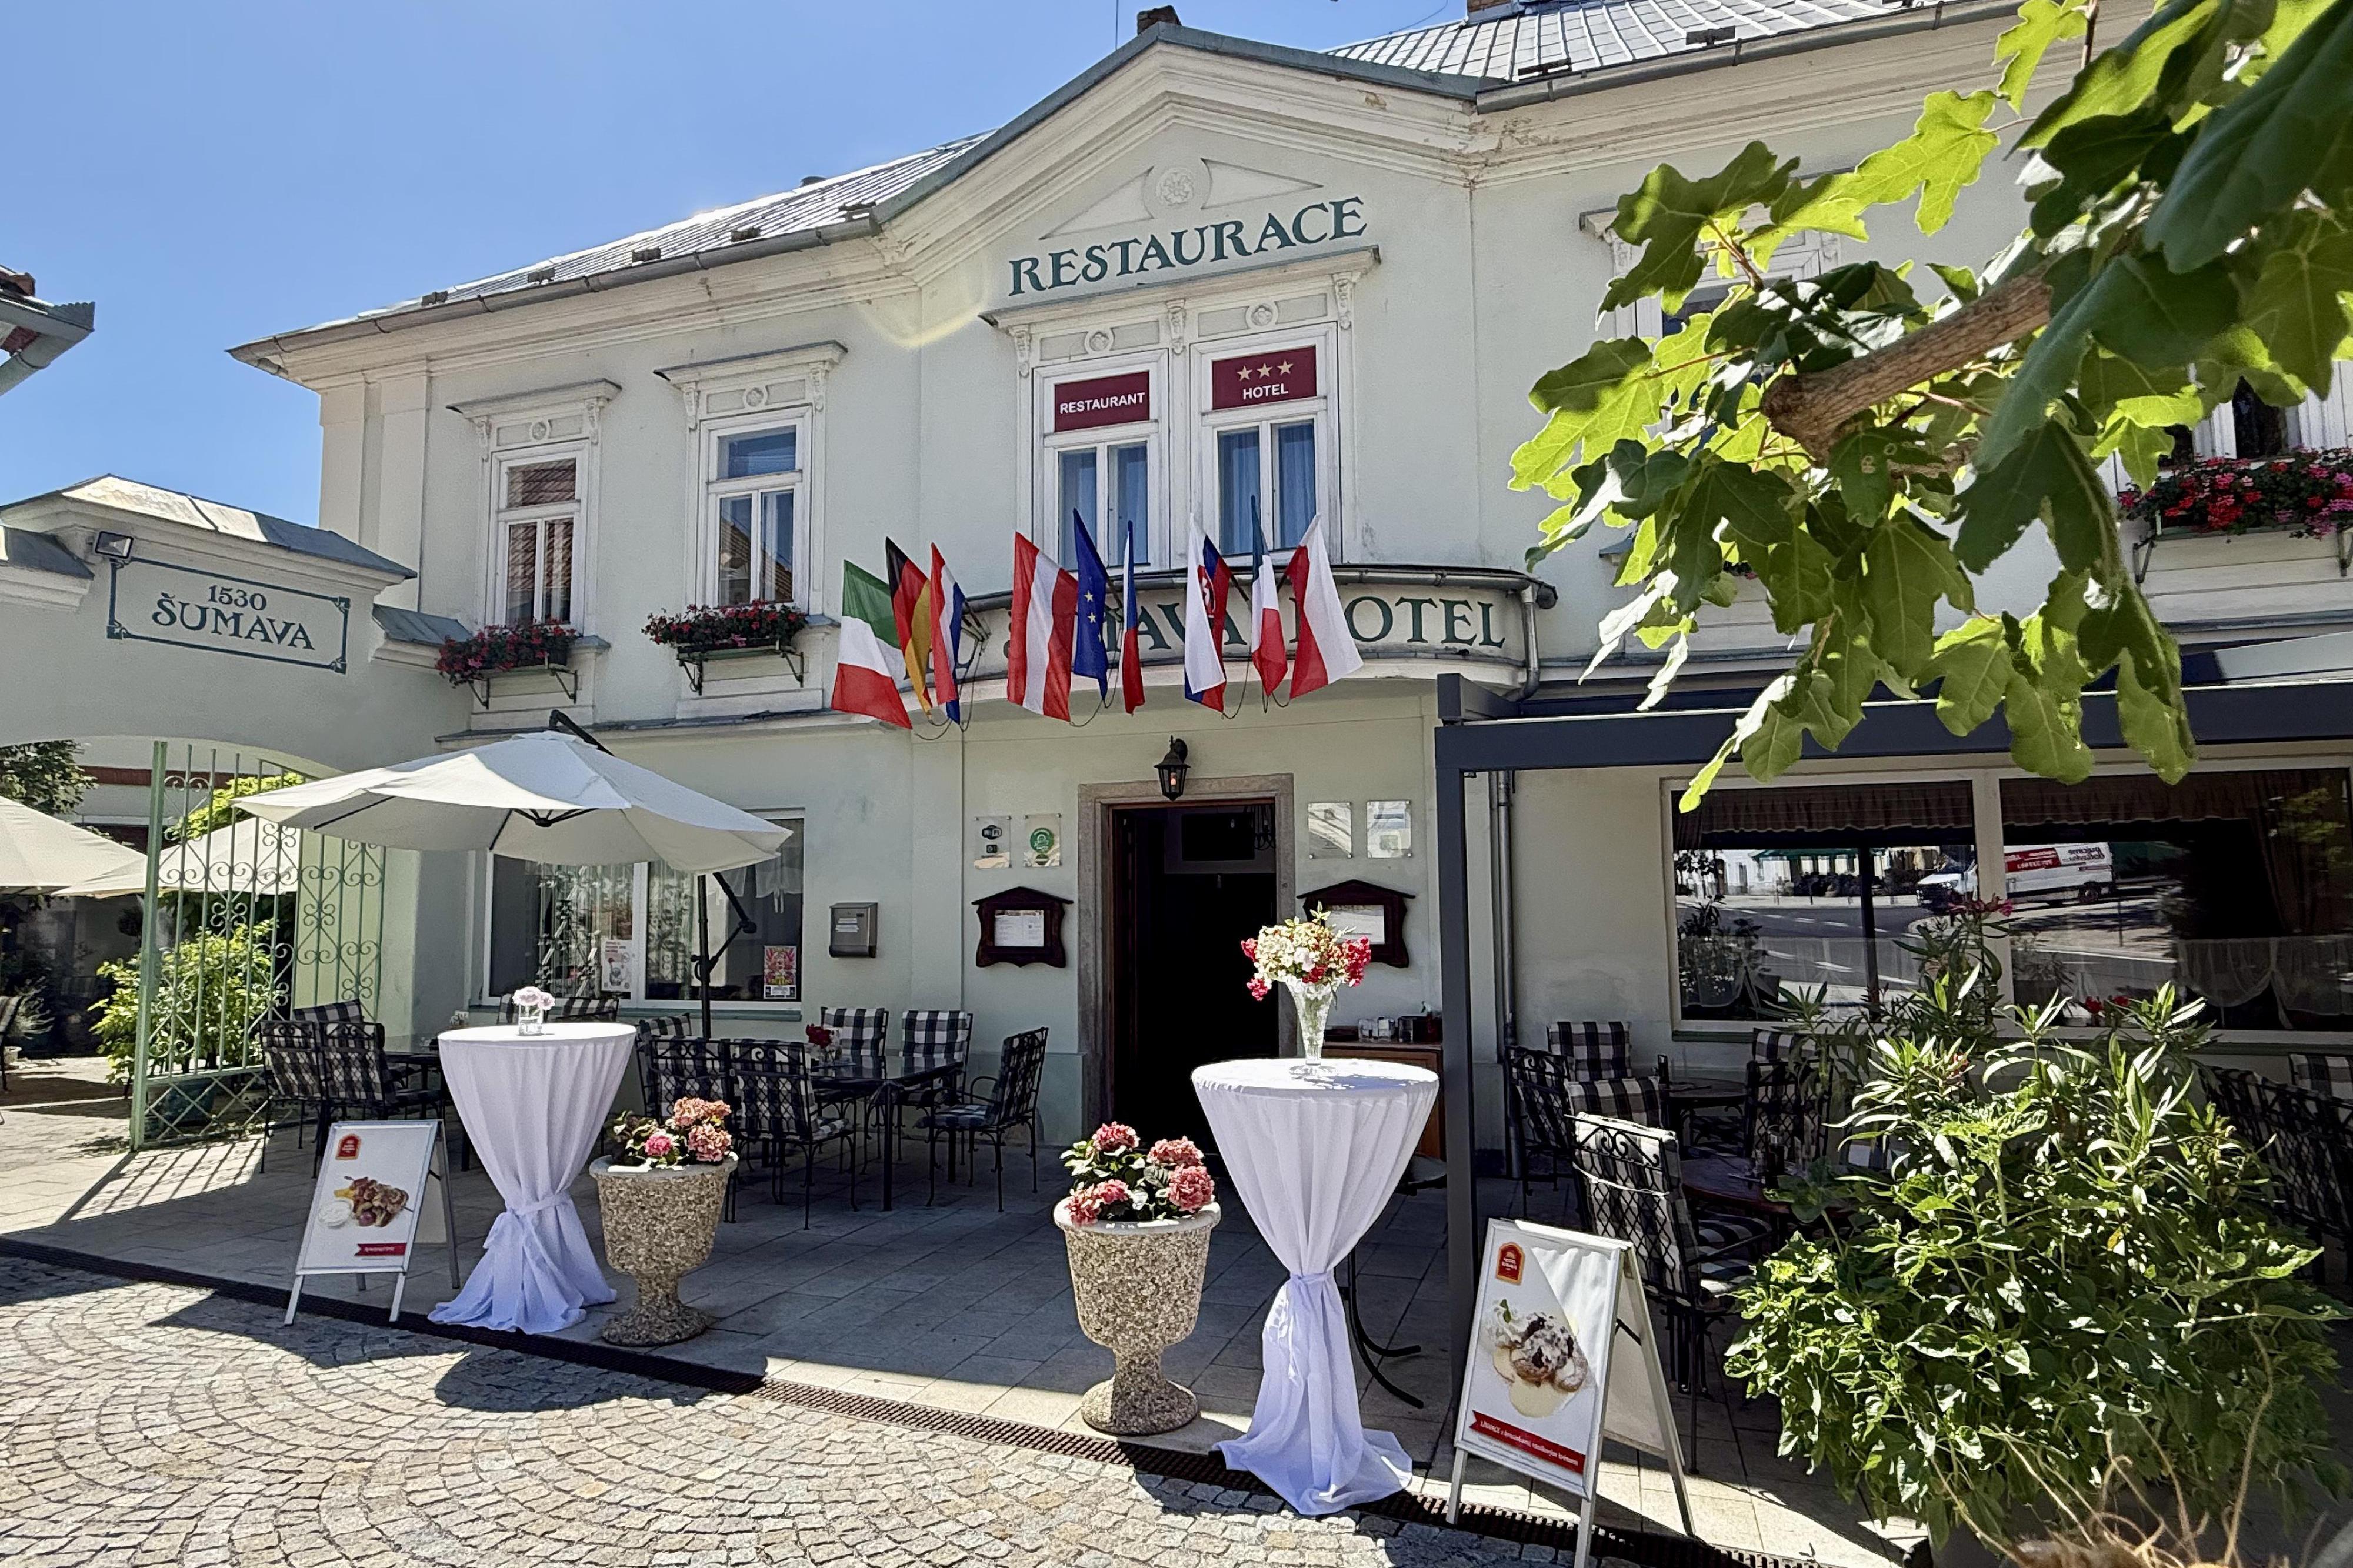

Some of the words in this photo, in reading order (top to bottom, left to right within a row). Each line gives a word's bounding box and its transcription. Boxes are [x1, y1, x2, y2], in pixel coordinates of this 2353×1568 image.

[1008, 196, 1368, 297] RESTAURACE
[1060, 392, 1145, 415] RESTAURANT
[1242, 383, 1289, 399] HOTEL
[207, 584, 267, 611] 1530
[152, 592, 316, 651] ŠUMAVA
[1288, 595, 1506, 649] OTEL
